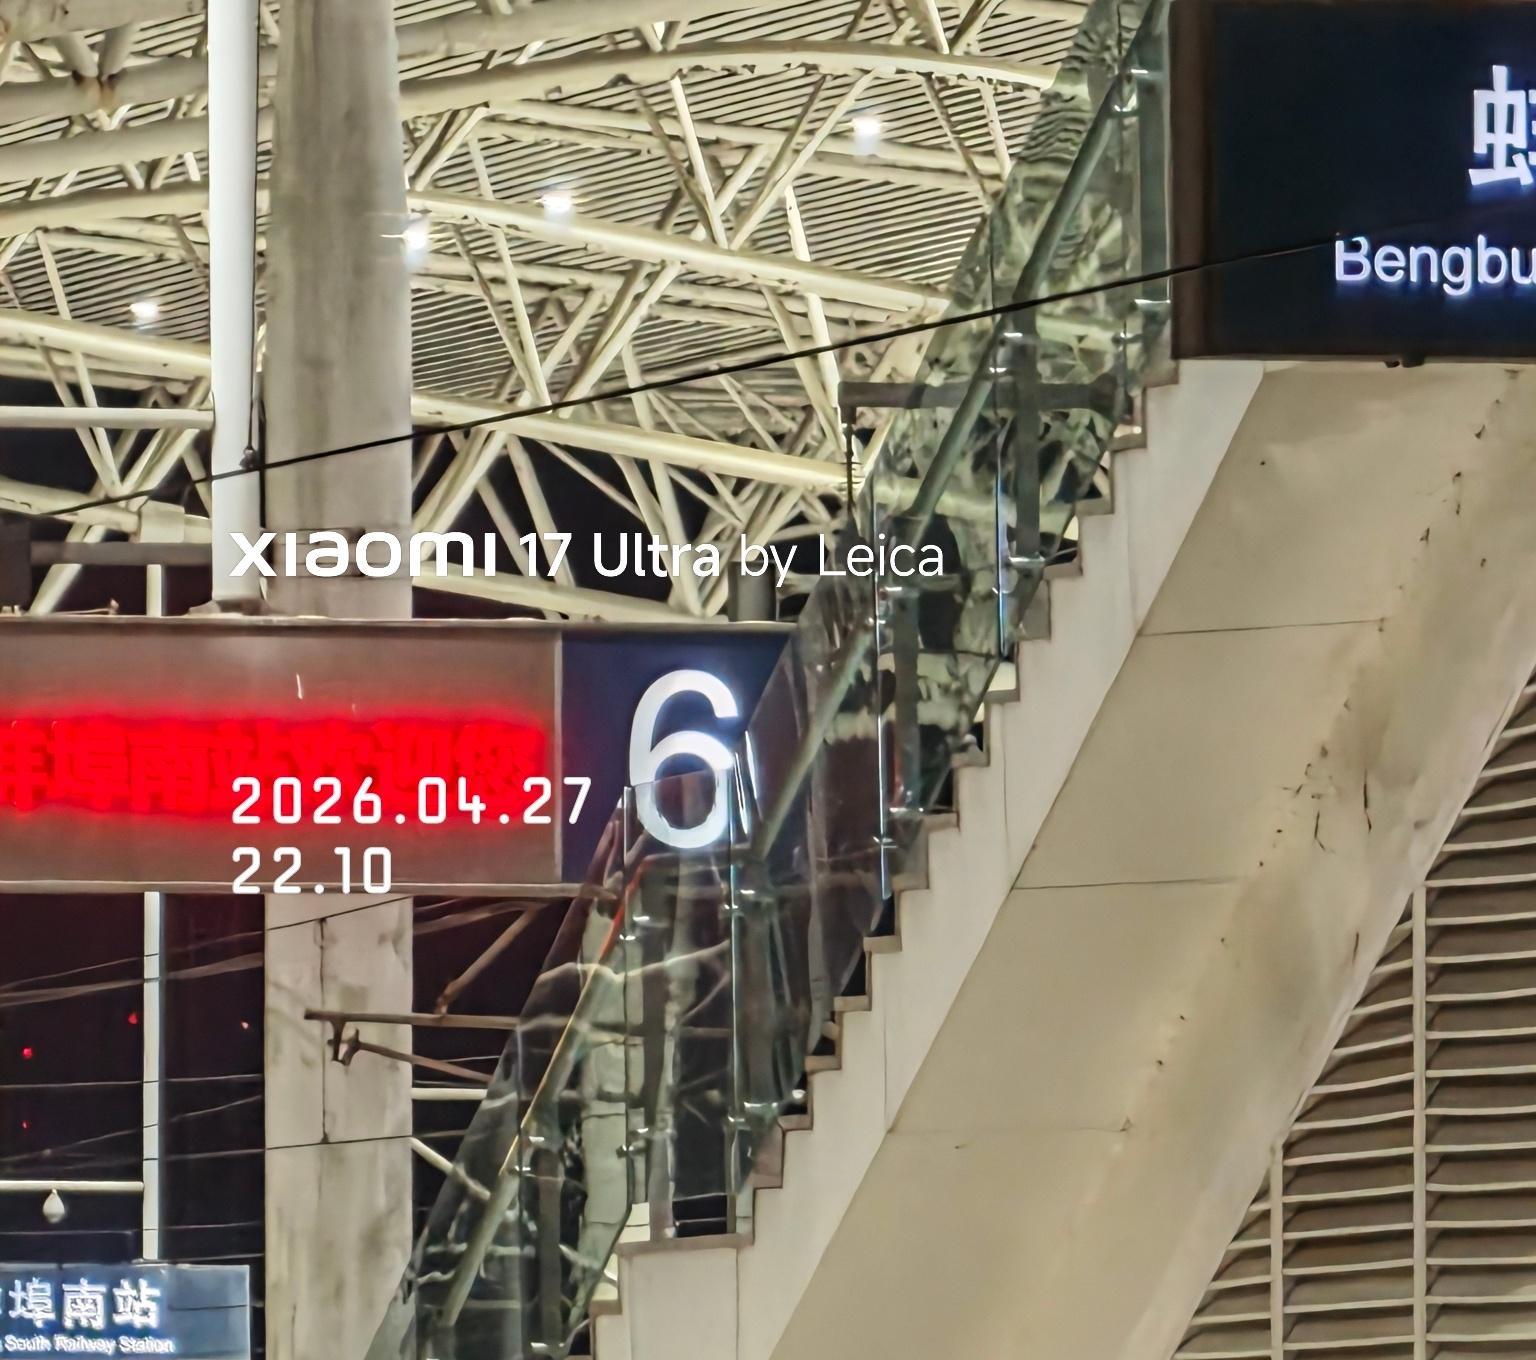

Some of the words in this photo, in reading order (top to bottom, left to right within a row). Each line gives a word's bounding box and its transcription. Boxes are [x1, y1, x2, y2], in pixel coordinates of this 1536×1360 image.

[628, 669, 740, 850] 6
[0, 1277, 161, 1329] 埠南站
